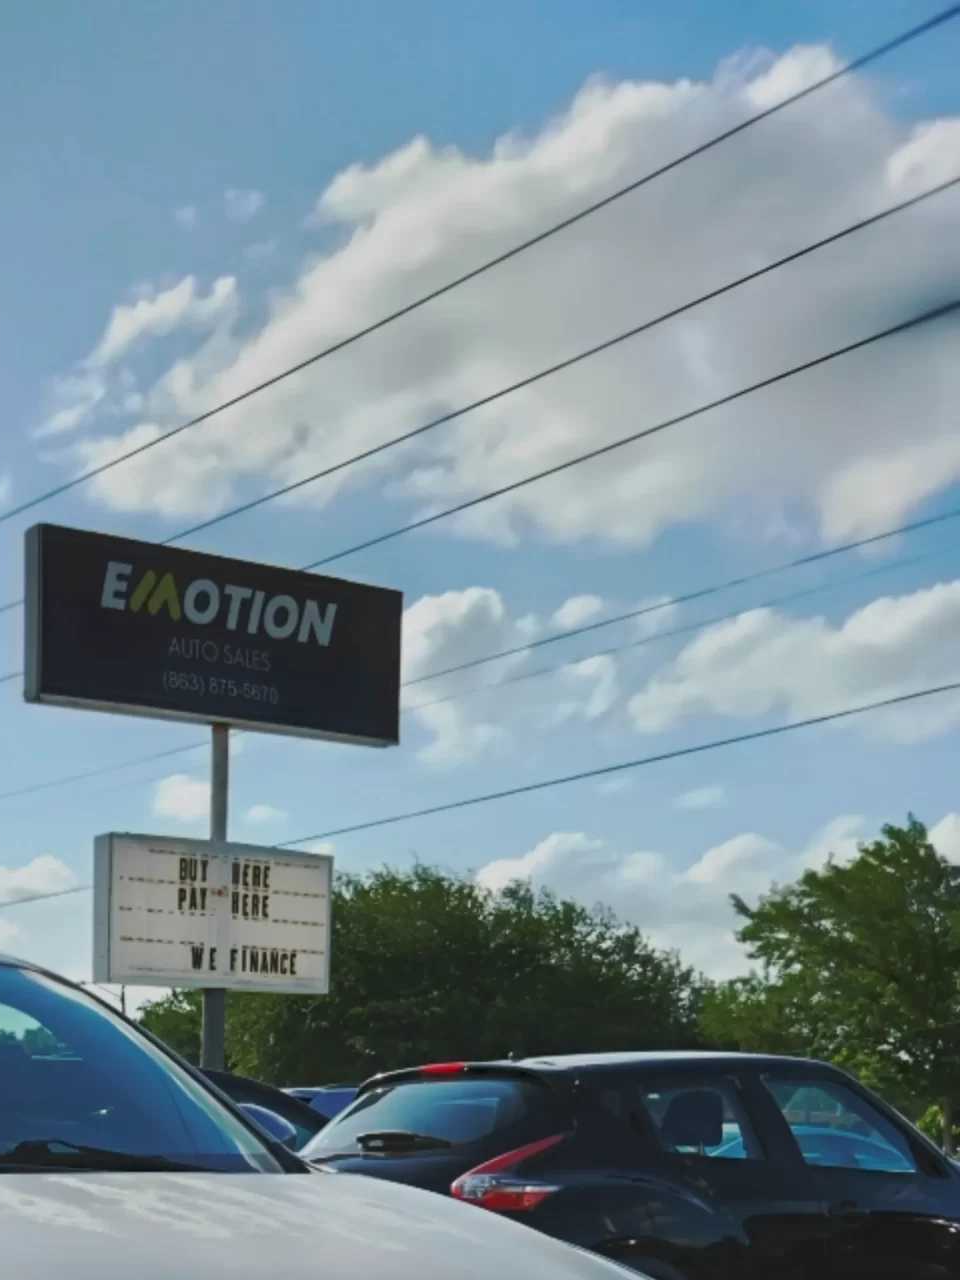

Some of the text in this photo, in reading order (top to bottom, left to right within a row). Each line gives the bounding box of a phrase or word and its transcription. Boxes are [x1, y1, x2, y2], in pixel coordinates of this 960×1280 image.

[101, 560, 337, 646] EMOTION
[168, 636, 271, 672] AUTO SALES
[162, 670, 205, 696] (863)
[178, 857, 271, 888] BUY HERE
[177, 887, 269, 918] PAY HERE
[191, 945, 297, 974] WE FINANCE
